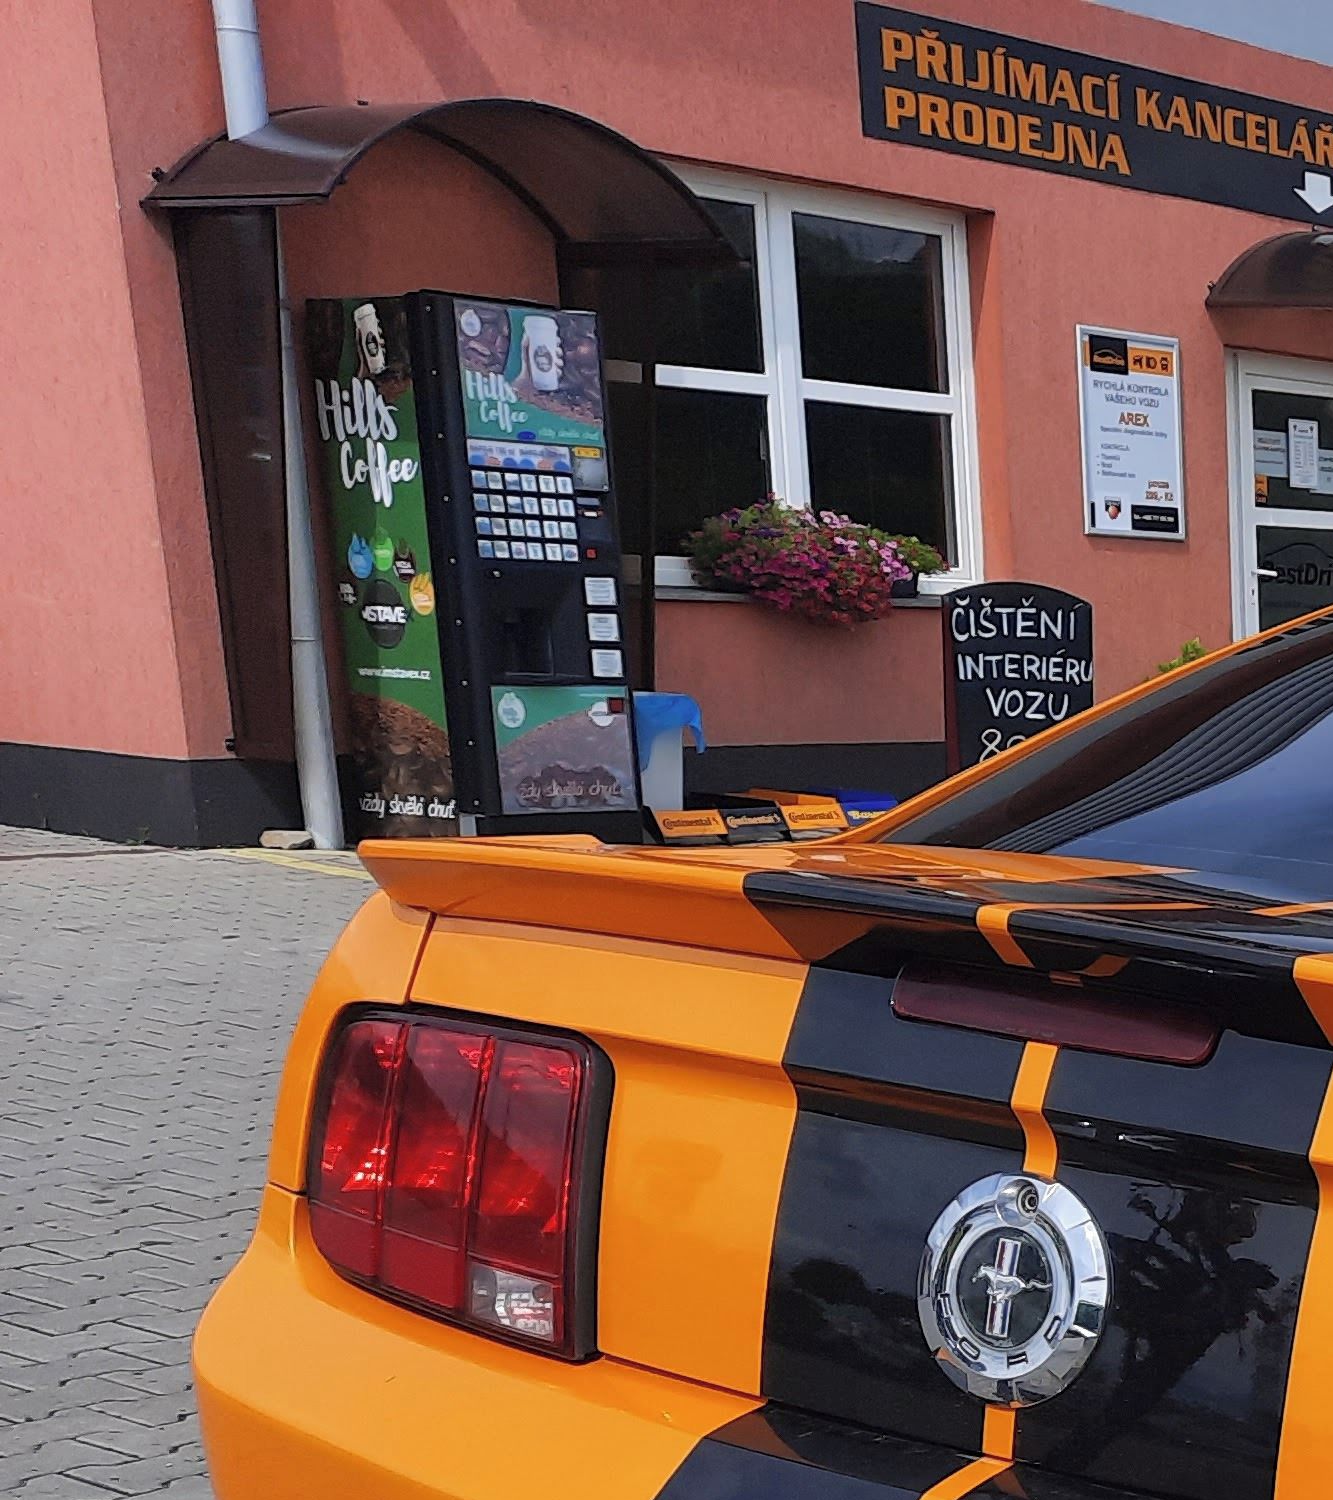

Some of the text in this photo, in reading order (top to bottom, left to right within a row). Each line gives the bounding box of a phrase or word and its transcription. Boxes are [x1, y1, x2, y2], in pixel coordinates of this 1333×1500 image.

[880, 28, 1121, 122] PŘIJÍMACÍ
[883, 85, 1132, 177] PRODEJNA
[315, 377, 399, 442] Hills
[465, 369, 517, 404] Hills
[1118, 411, 1150, 427] AREX
[341, 437, 418, 508] Coffee
[951, 595, 1085, 641] ČIŠTĚNÍ
[956, 648, 1093, 686] INTERIÉRU
[986, 687, 1068, 721] VOZU
